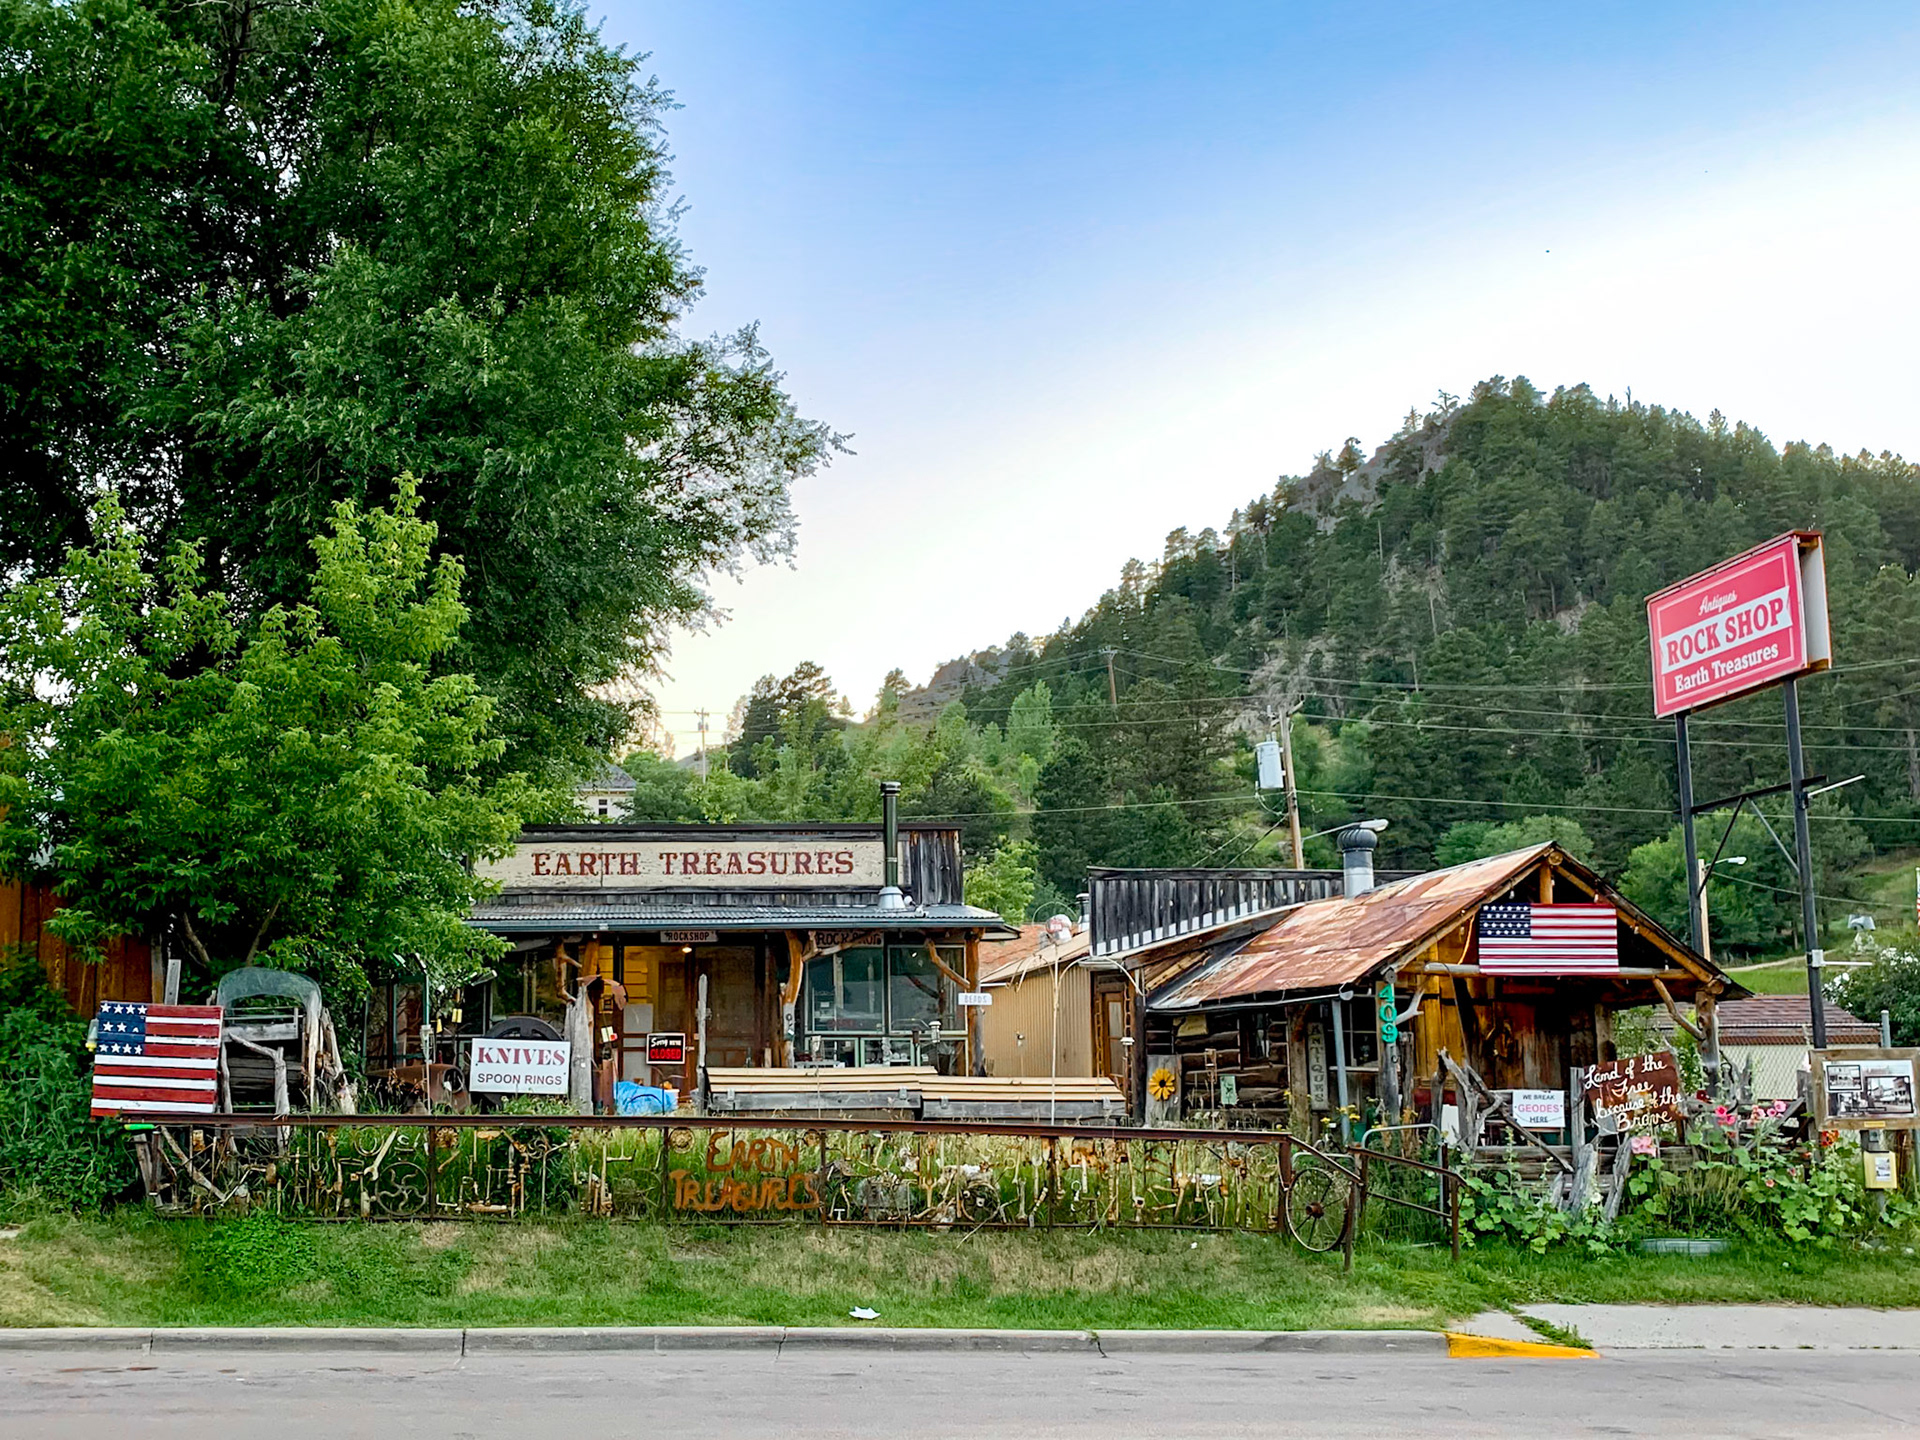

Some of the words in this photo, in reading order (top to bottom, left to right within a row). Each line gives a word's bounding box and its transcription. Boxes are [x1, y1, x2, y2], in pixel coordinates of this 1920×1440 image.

[1698, 590, 1737, 616] Antiques
[1666, 622, 1721, 667] ROCK
[1725, 597, 1784, 643] SHOP
[1674, 665, 1710, 693] Earth
[1711, 643, 1779, 680] Treasures
[531, 851, 642, 876] EARTH
[658, 851, 855, 876] TREASURES
[1378, 983, 1399, 1043] 409
[477, 1046, 566, 1067] KNIVES
[650, 1048, 682, 1060] CLOSED
[1309, 1024, 1325, 1103] ANTIQUES
[477, 1073, 521, 1085] SPOON
[524, 1074, 563, 1086] RINGS
[1584, 1062, 1622, 1089] Land
[1624, 1058, 1635, 1080] of
[1641, 1054, 1668, 1074] the
[1611, 1078, 1655, 1098] Free
[1517, 1103, 1560, 1113] GEODES
[1595, 1098, 1645, 1120] because
[1659, 1085, 1684, 1107] the
[1529, 1116, 1549, 1124] HERE
[1616, 1110, 1673, 1133] Brave
[706, 1131, 799, 1172] EARTH
[668, 1168, 821, 1213] TREASURES
